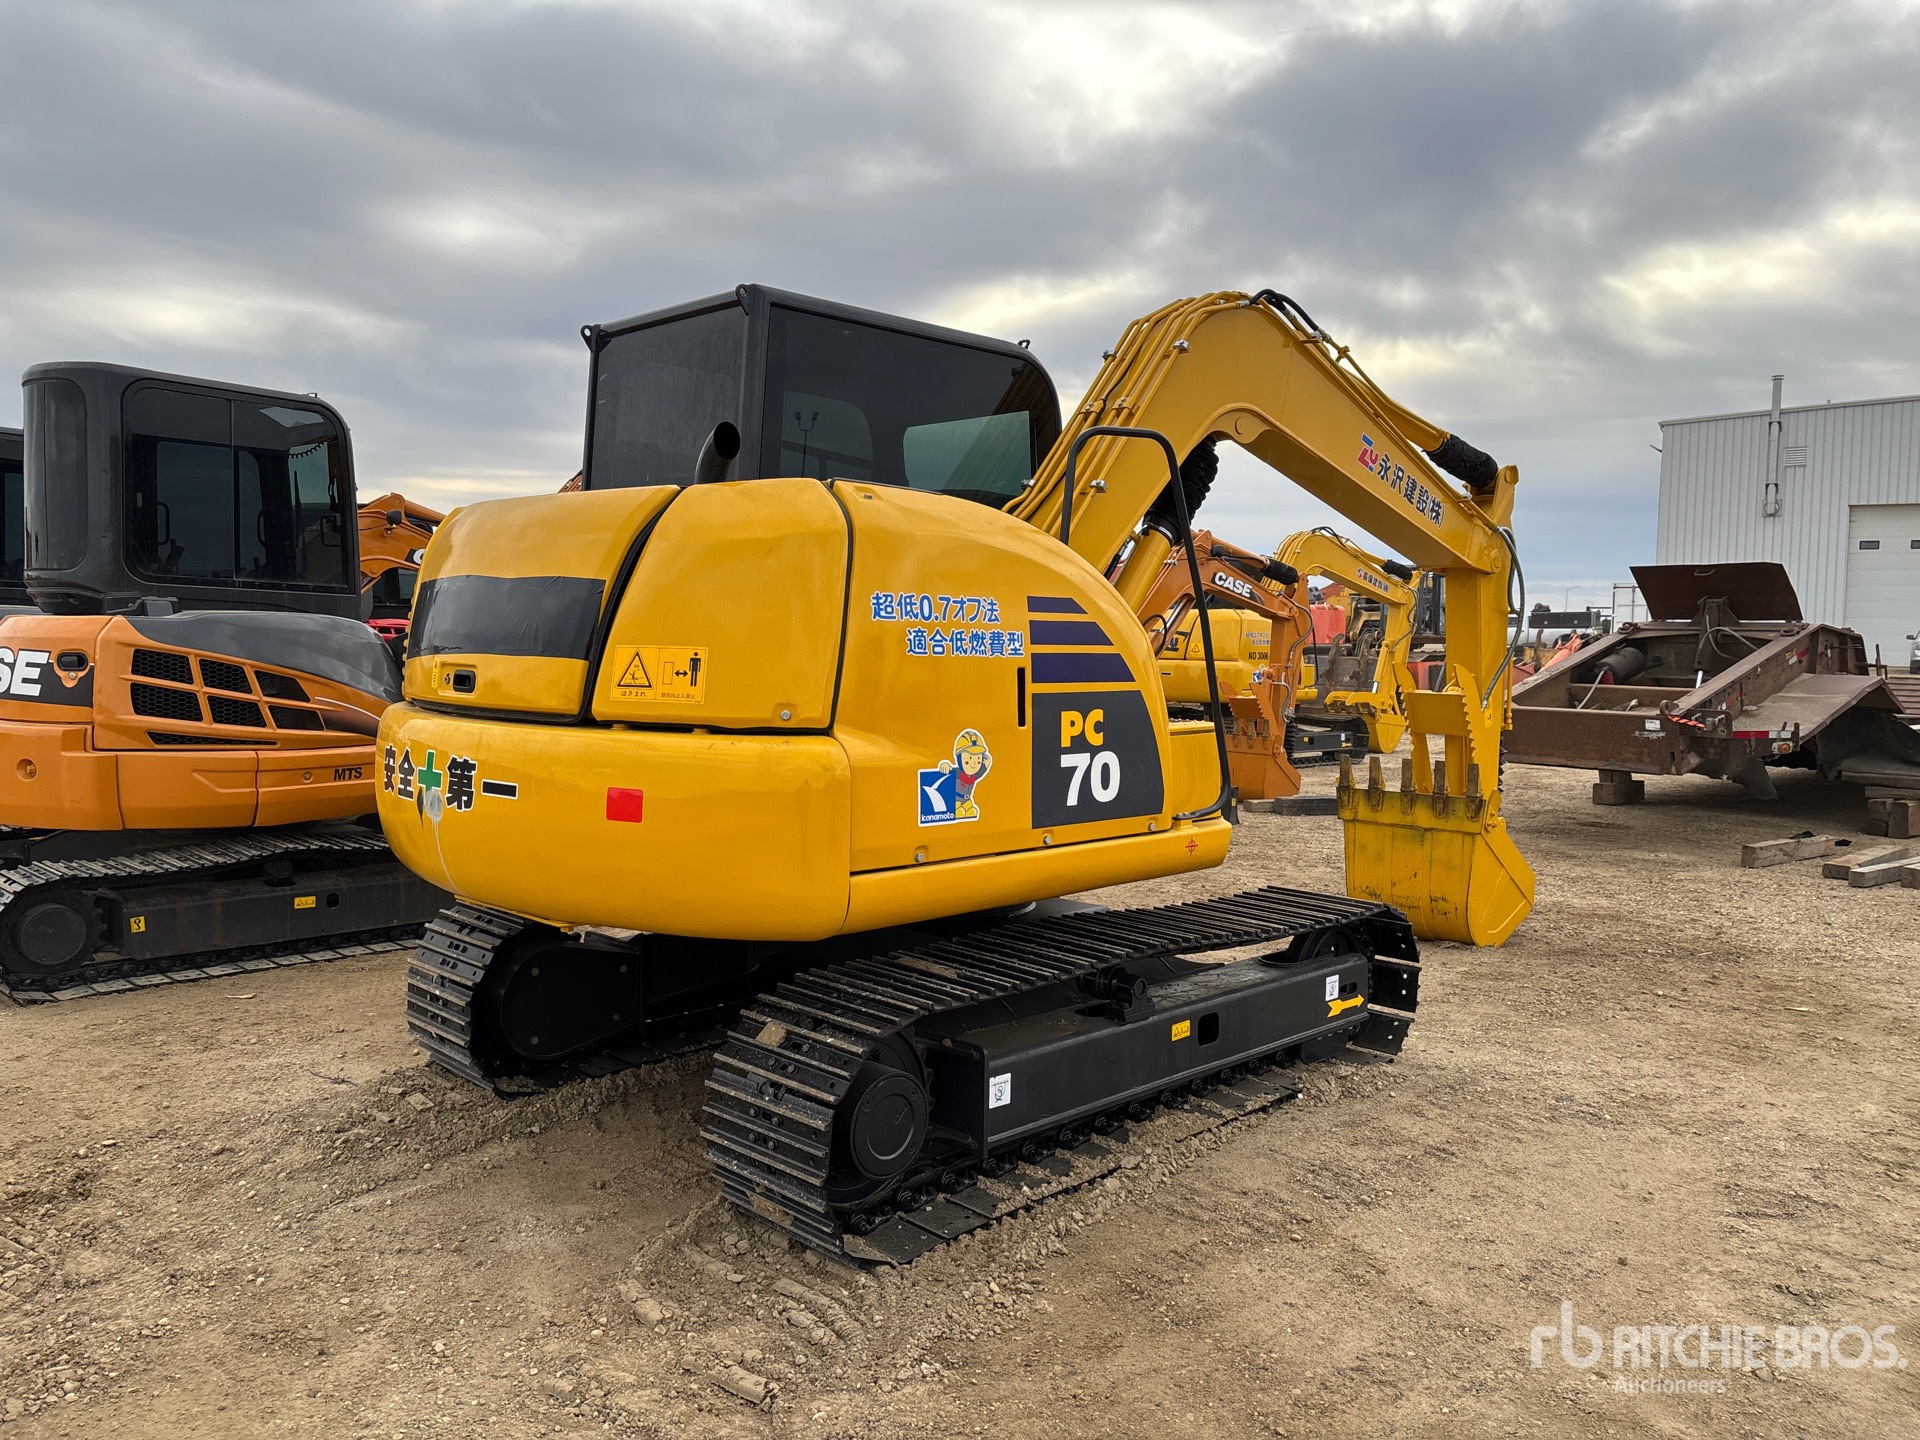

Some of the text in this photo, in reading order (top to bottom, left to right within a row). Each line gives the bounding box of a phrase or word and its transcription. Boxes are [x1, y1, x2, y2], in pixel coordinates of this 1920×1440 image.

[1214, 571, 1253, 598] CASE
[906, 627, 1024, 657] 適合低燃費型
[1060, 708, 1104, 748] PC
[333, 766, 363, 781] MTS
[1060, 751, 1121, 807] 70
[921, 811, 955, 822] kanamoto
